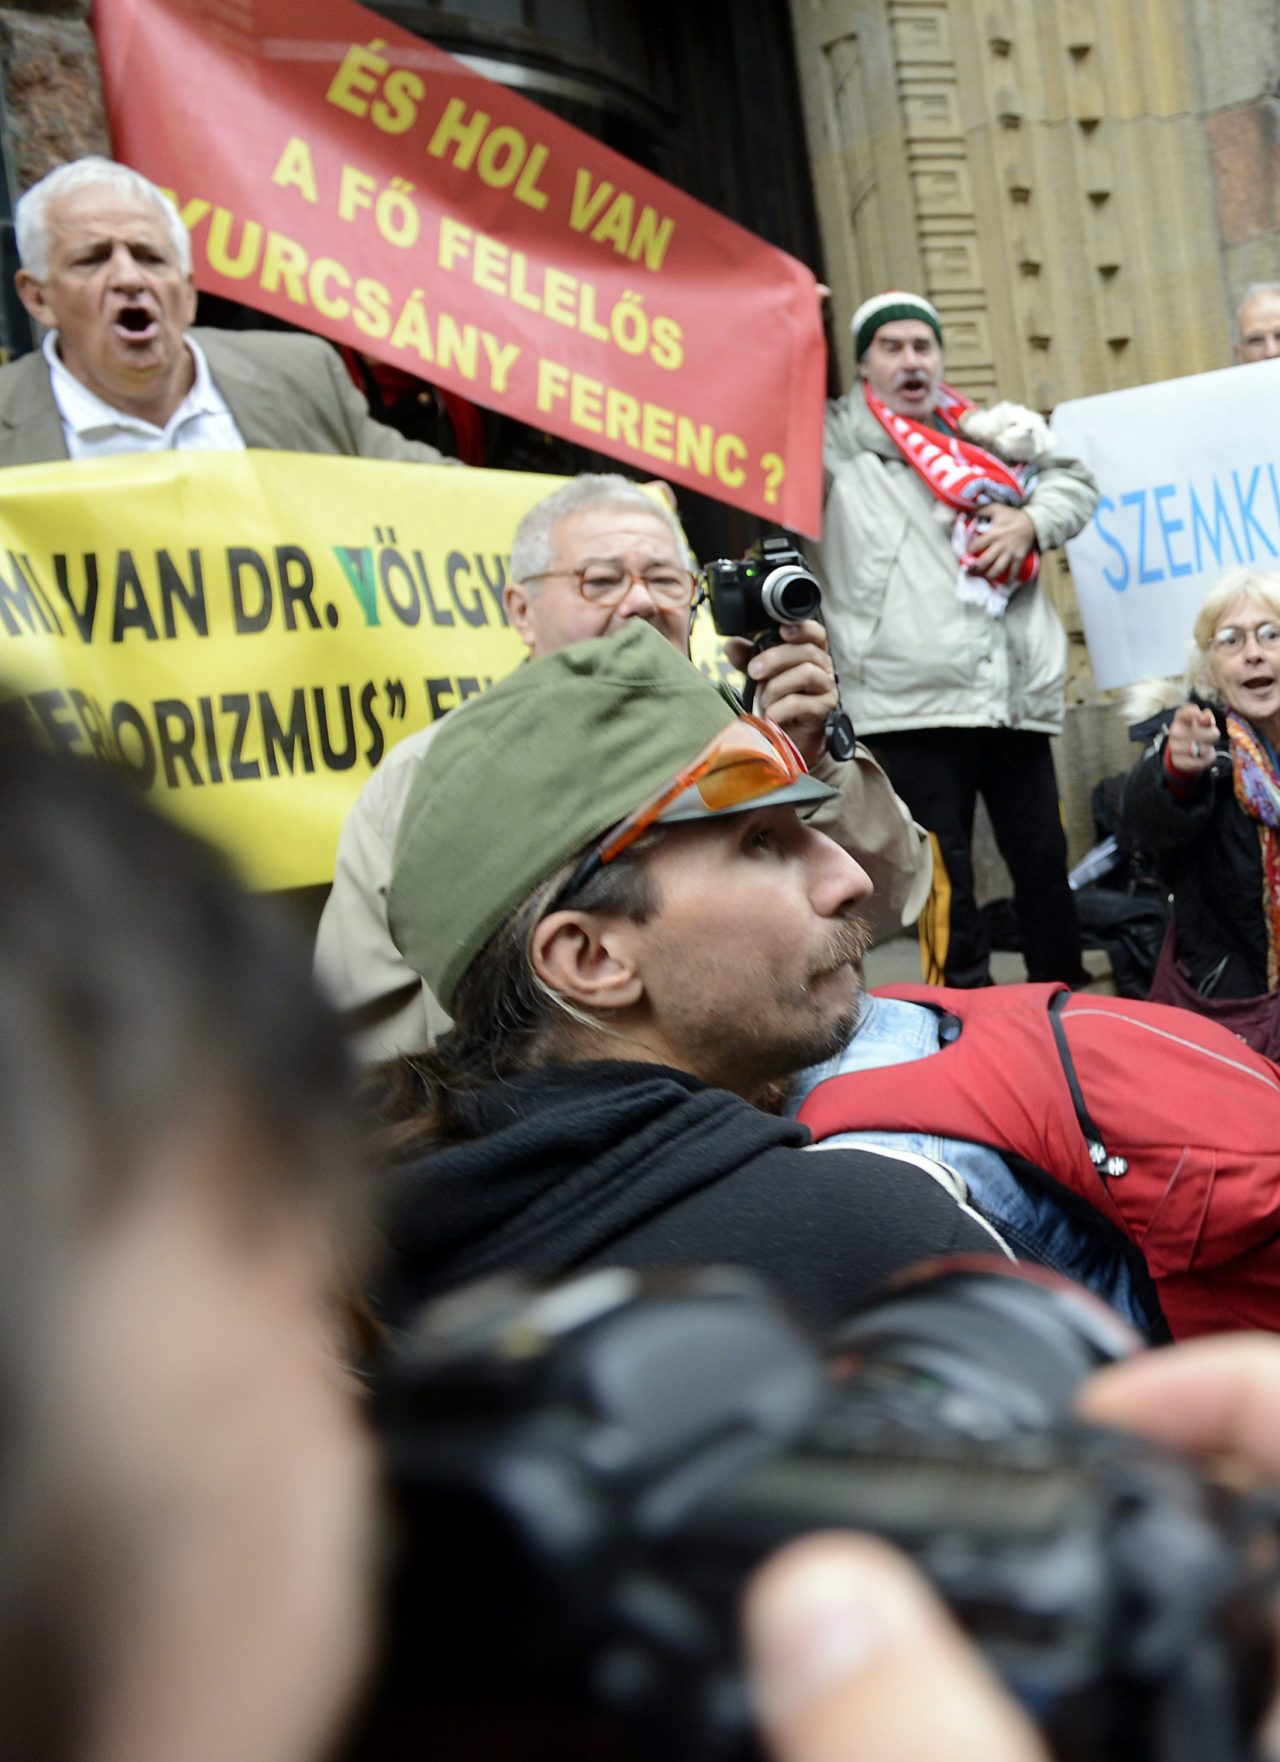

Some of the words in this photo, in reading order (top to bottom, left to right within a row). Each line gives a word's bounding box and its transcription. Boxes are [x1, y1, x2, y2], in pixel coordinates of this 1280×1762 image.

[325, 38, 425, 135] ÉS
[426, 96, 551, 209] HOL
[568, 167, 675, 272] VAN
[271, 136, 318, 203] A
[437, 215, 685, 371] FELELŐS
[537, 358, 747, 490] FERENC
[758, 453, 786, 504] ?
[53, 547, 210, 645] VAN
[225, 545, 340, 637] DR.
[332, 526, 511, 629] VÖLGY
